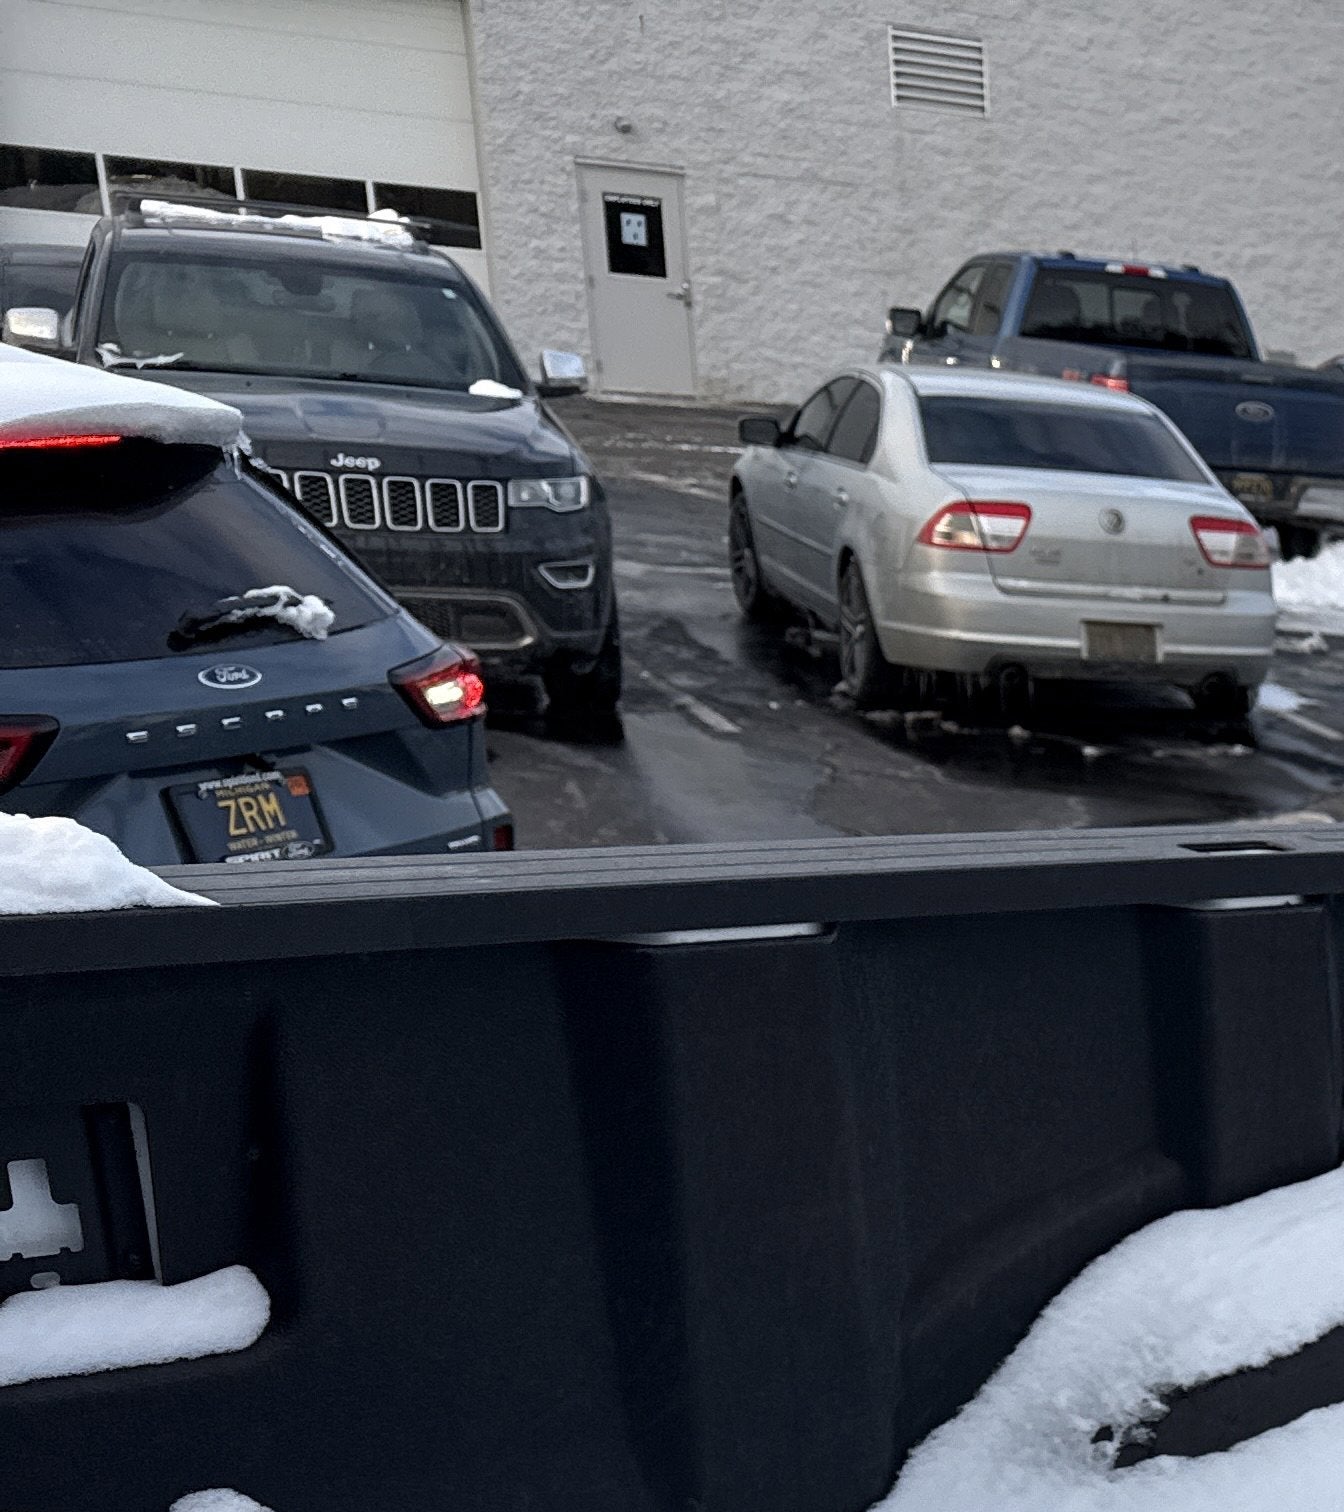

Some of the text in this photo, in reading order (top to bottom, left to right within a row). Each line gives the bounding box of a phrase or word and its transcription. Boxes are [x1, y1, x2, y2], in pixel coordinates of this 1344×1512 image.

[330, 453, 381, 471] Jeep
[126, 697, 358, 744] ESCAPE
[217, 792, 287, 837] ZRM
